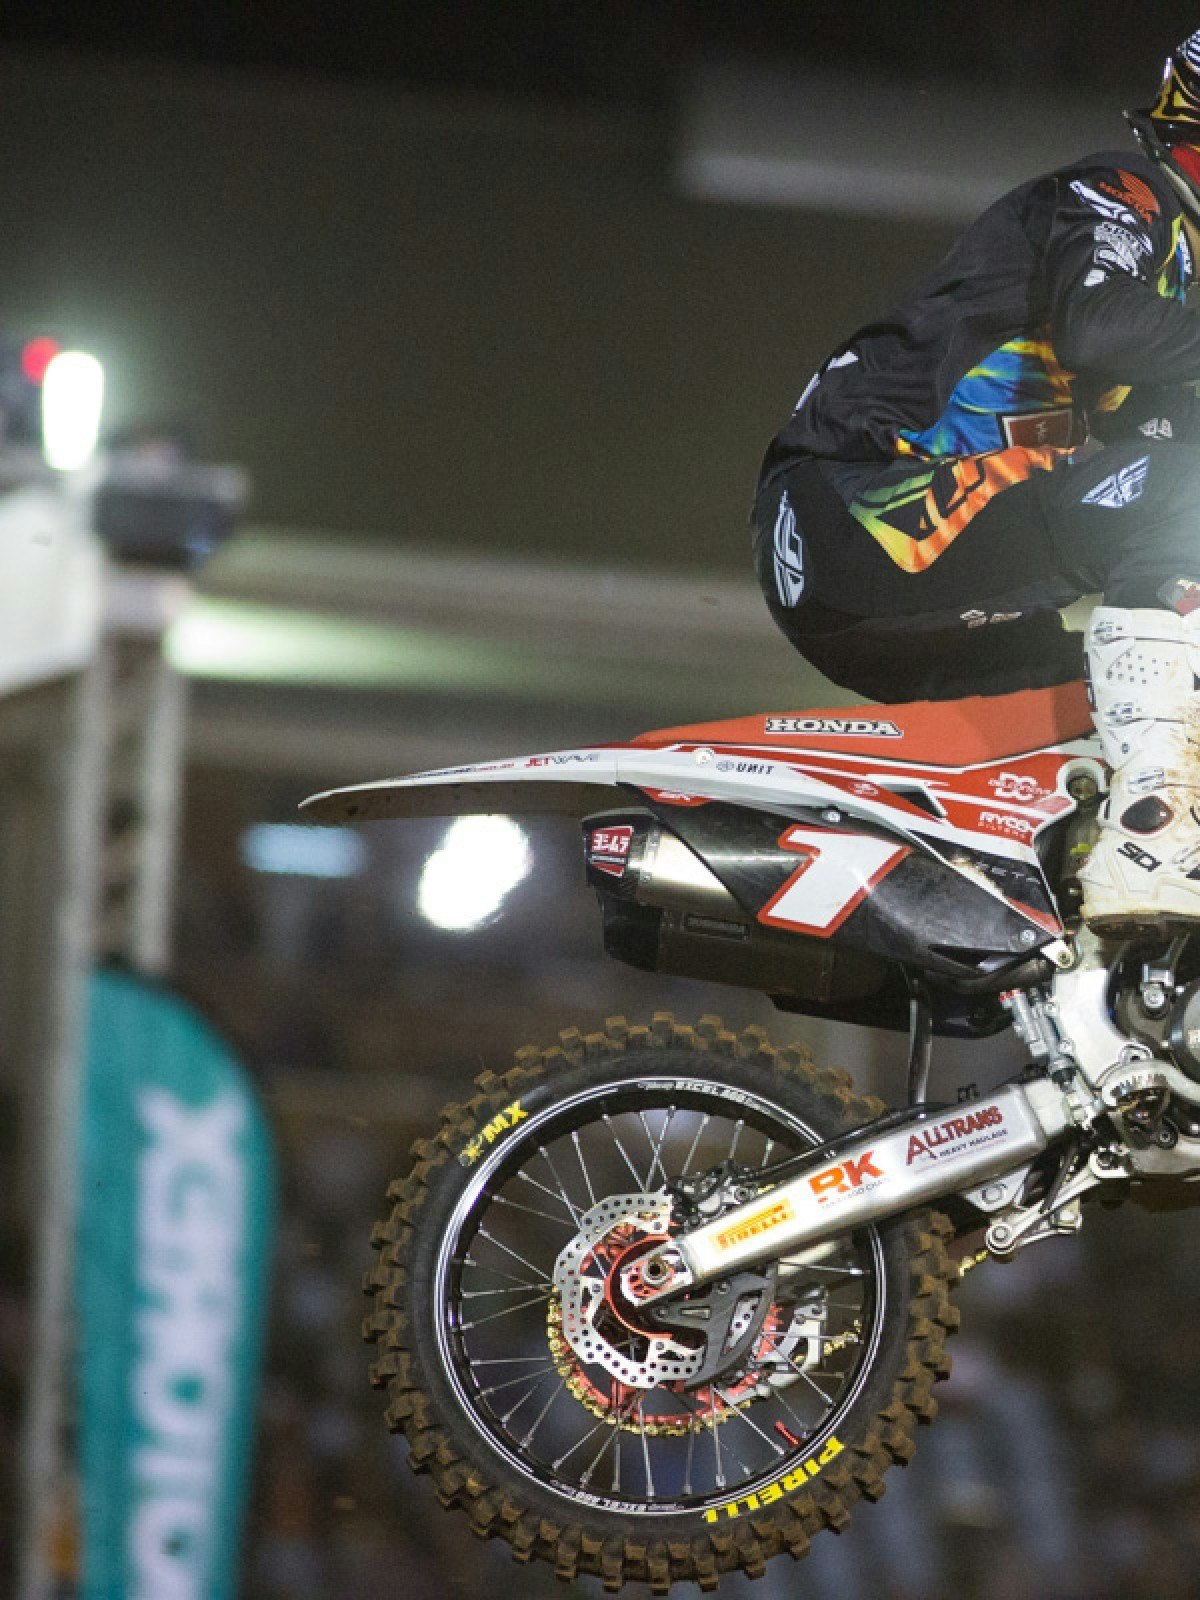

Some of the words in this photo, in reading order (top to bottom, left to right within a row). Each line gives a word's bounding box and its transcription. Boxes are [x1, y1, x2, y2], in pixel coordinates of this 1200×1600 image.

[765, 717, 903, 738] HONDA
[757, 823, 913, 938] 1
[484, 1100, 529, 1144] MX
[905, 1105, 1003, 1166] ALLTRANS
[807, 1149, 885, 1204] RK
[716, 1204, 788, 1249] PIRELLI
[703, 1435, 845, 1524] PIRELLI
